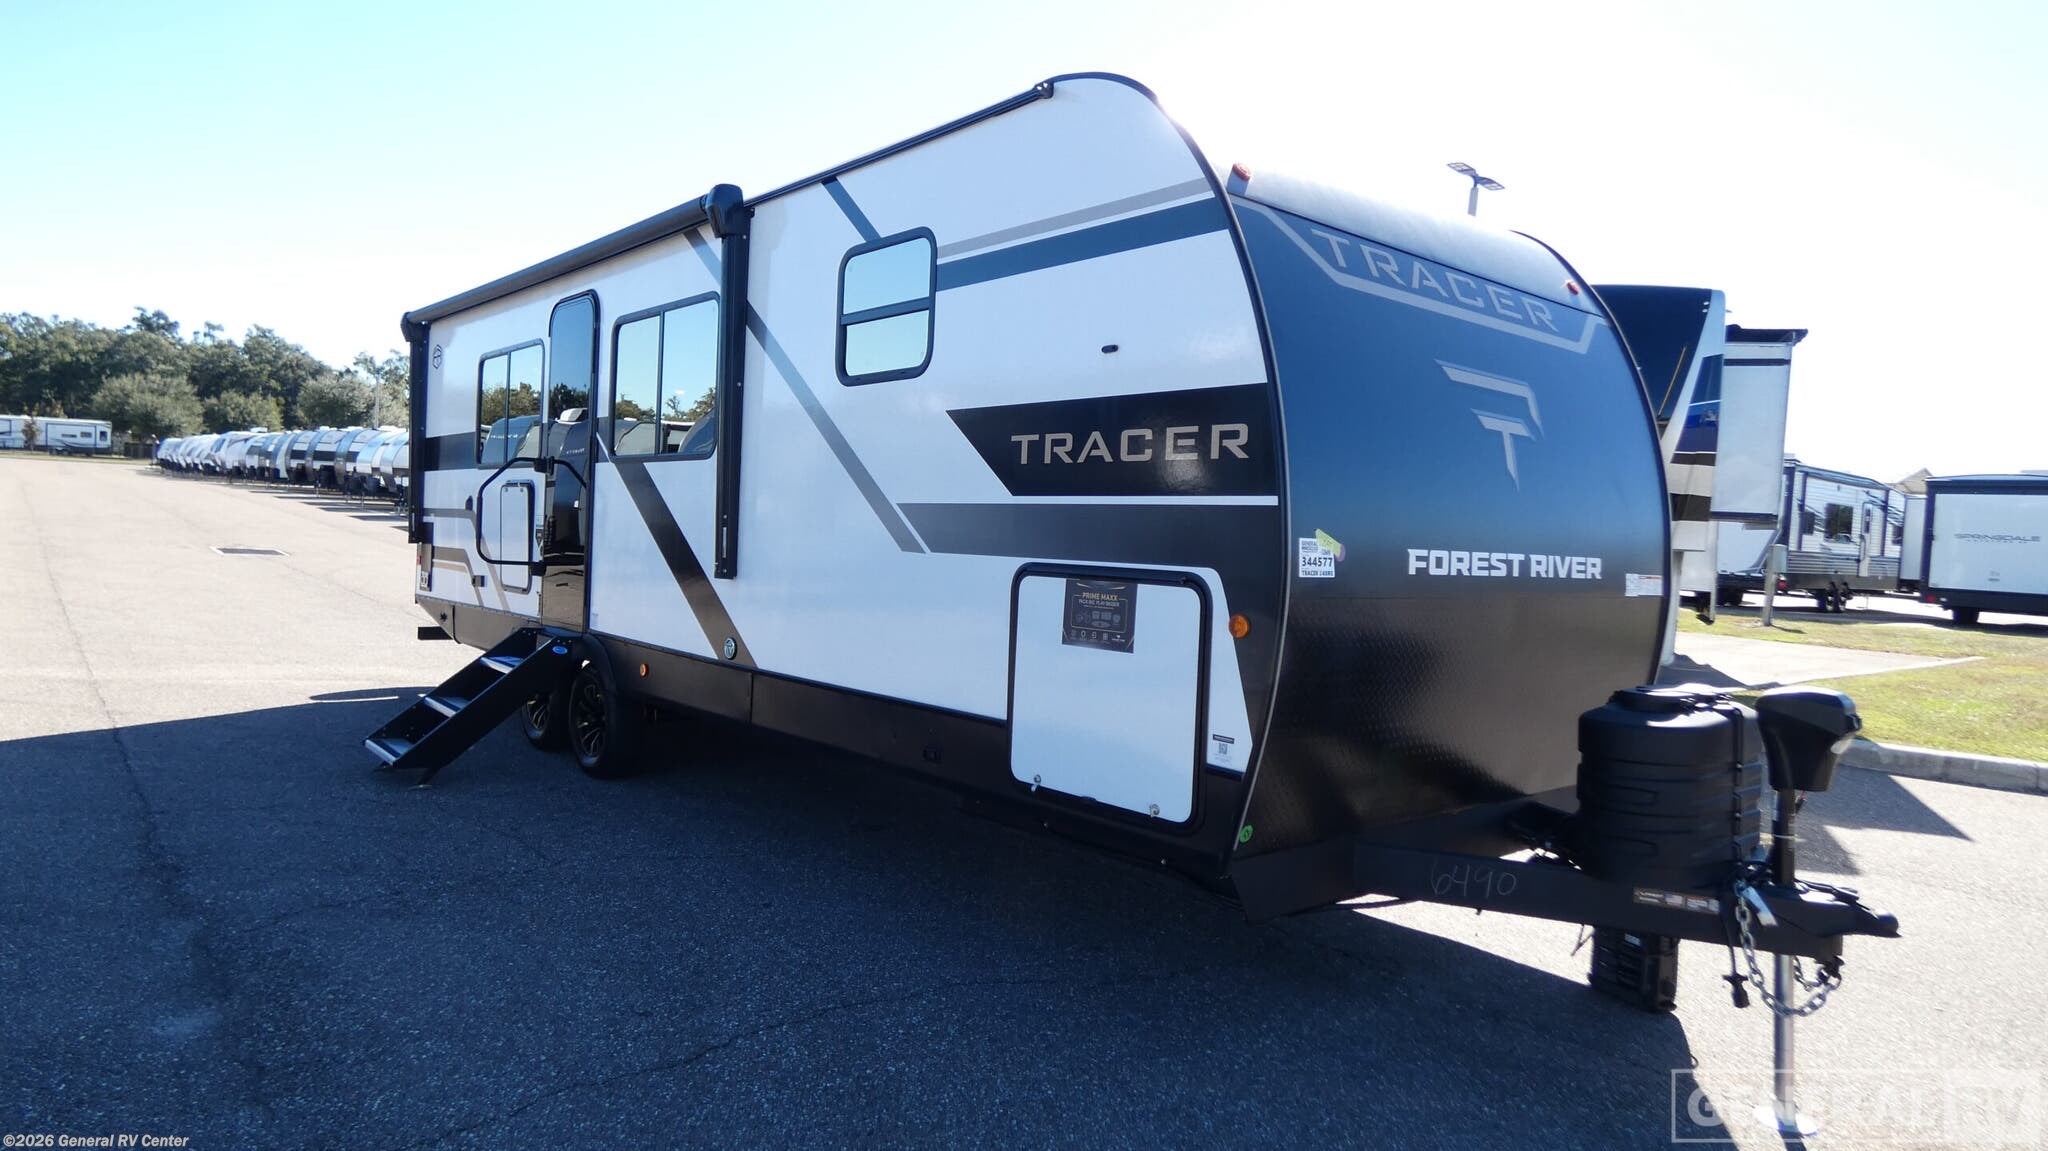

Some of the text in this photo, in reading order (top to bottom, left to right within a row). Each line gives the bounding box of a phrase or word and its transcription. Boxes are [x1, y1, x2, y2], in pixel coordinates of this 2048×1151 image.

[1311, 228, 1559, 333] TRACER
[1010, 422, 1250, 466] TRACER
[1301, 556, 1333, 568] 344577
[1407, 548, 1602, 580] FOREST RIVER
[1430, 861, 1518, 899] 6490
